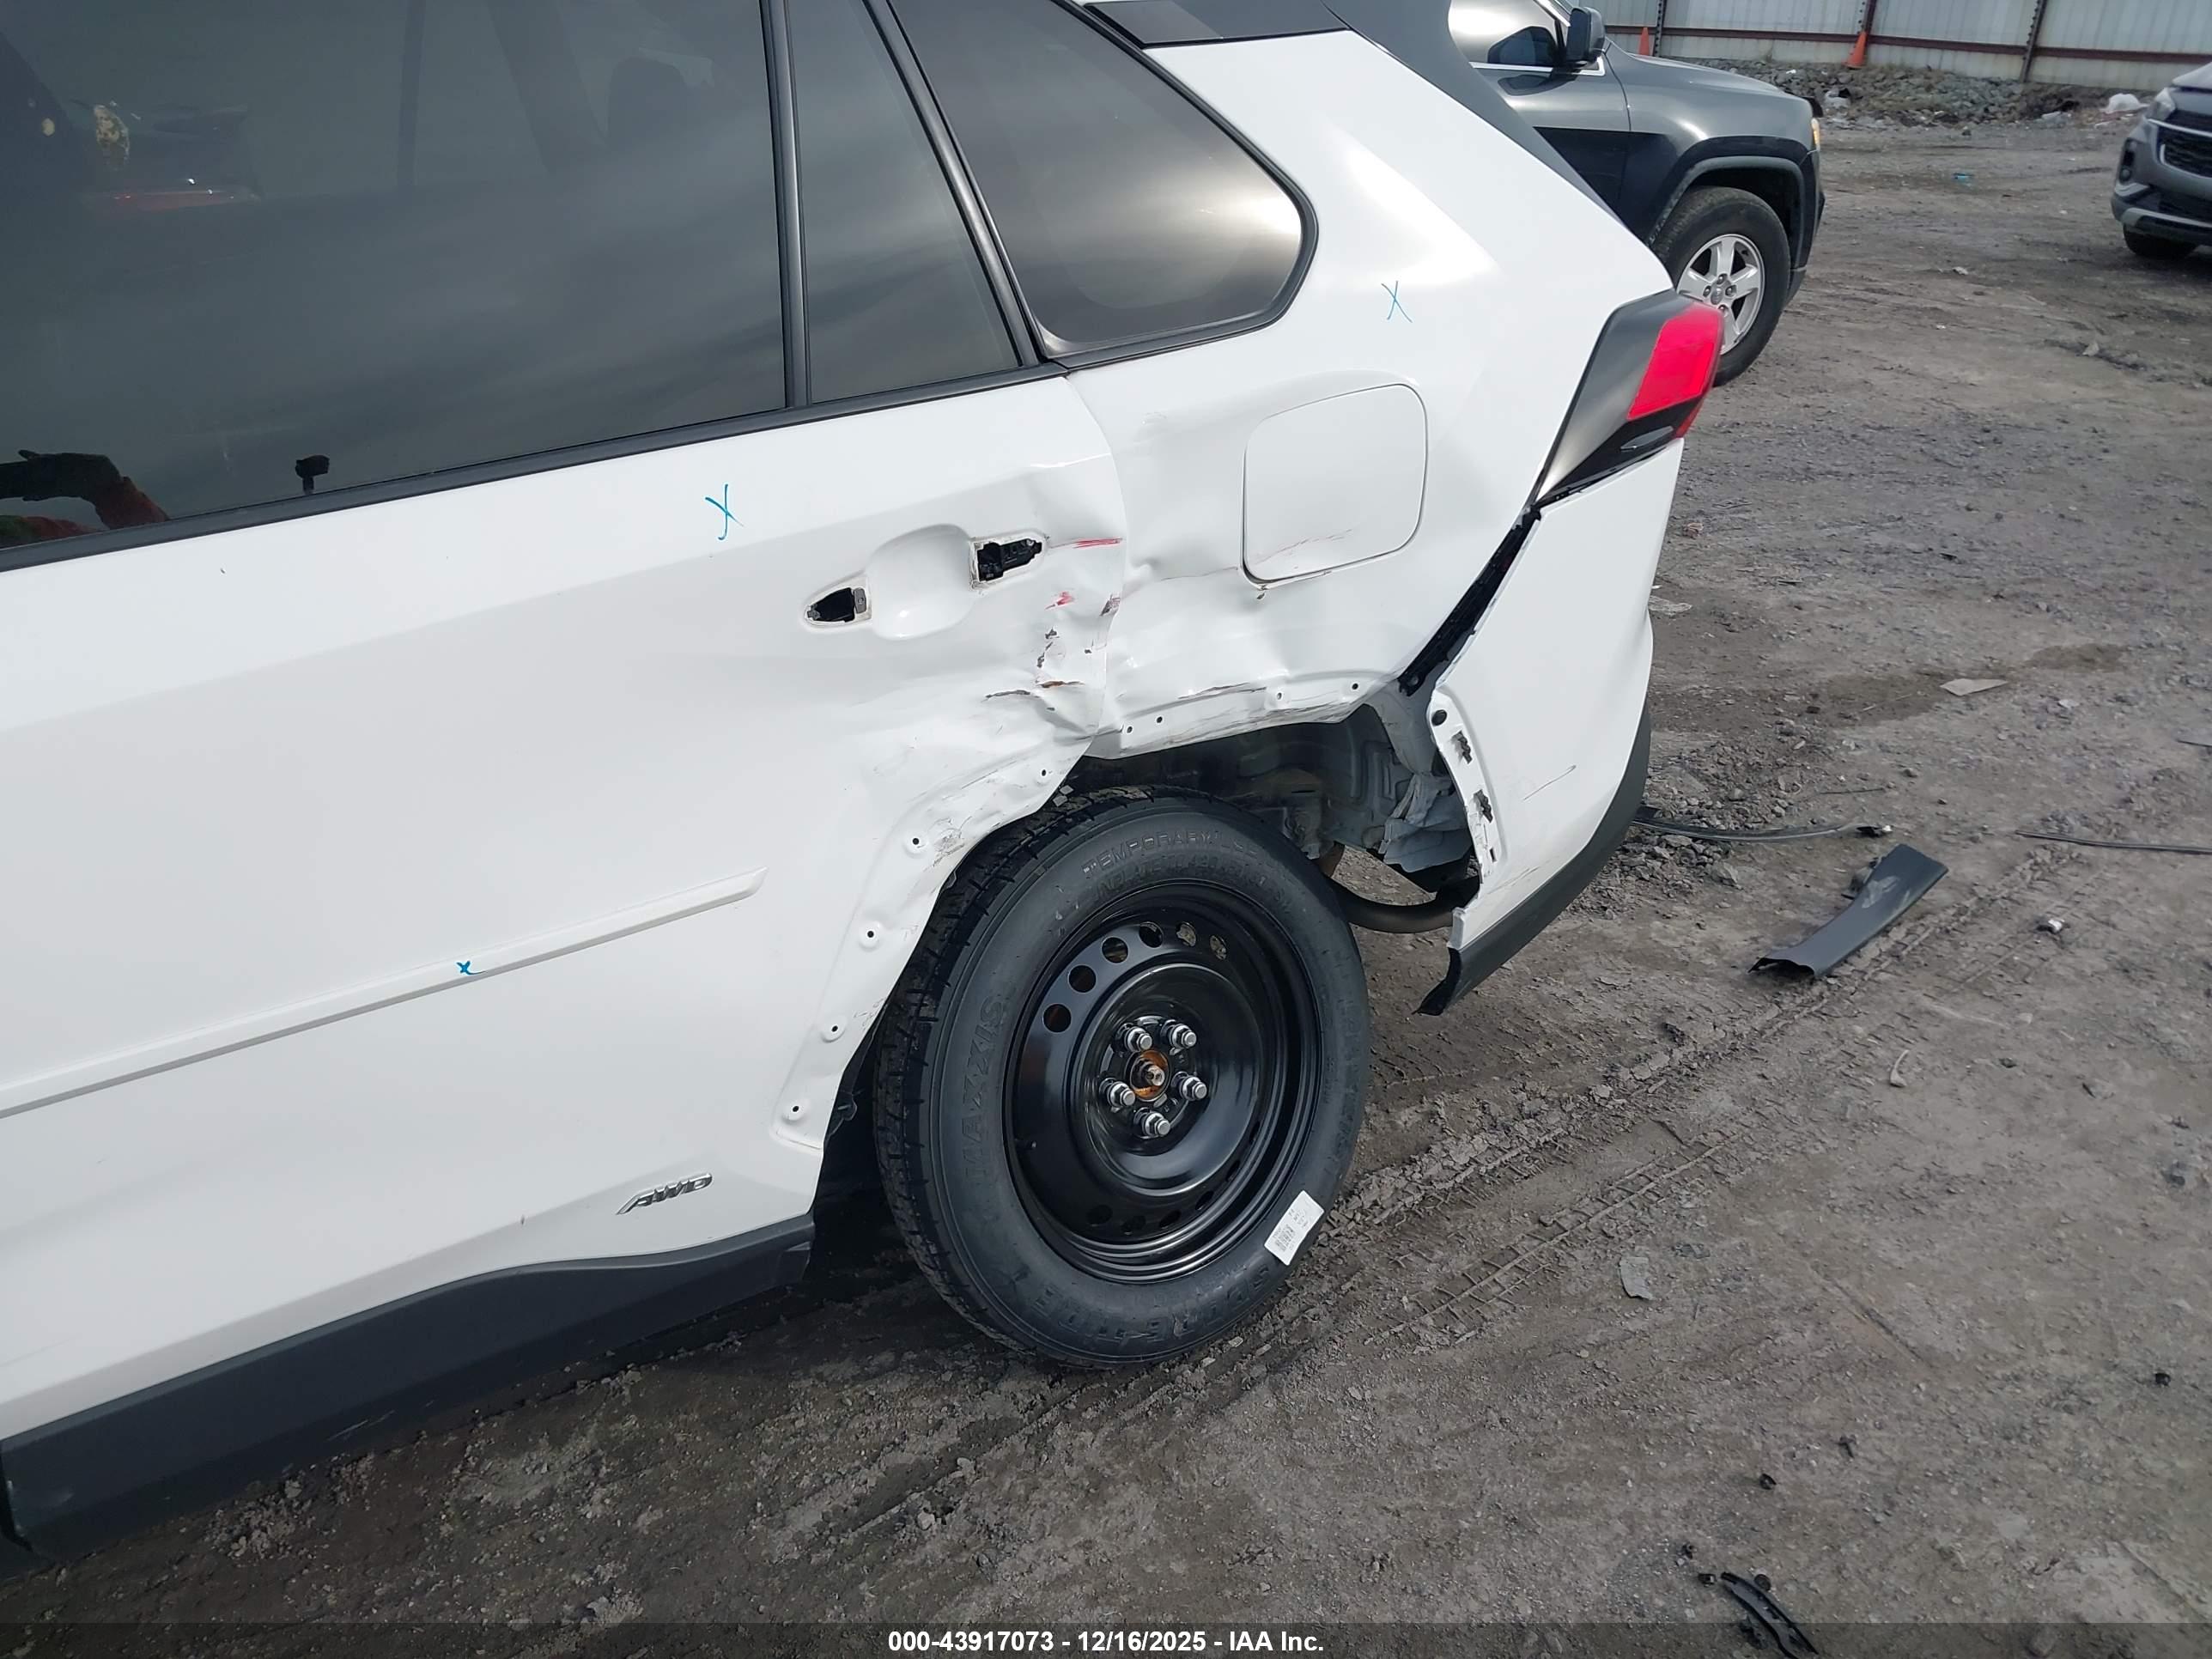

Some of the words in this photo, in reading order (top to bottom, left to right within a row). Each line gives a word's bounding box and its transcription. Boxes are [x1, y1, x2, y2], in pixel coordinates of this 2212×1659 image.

[1081, 830, 1213, 877] TEMPORARY
[961, 995, 1005, 1181] MAXXIS
[616, 1173, 713, 1215] AWD
